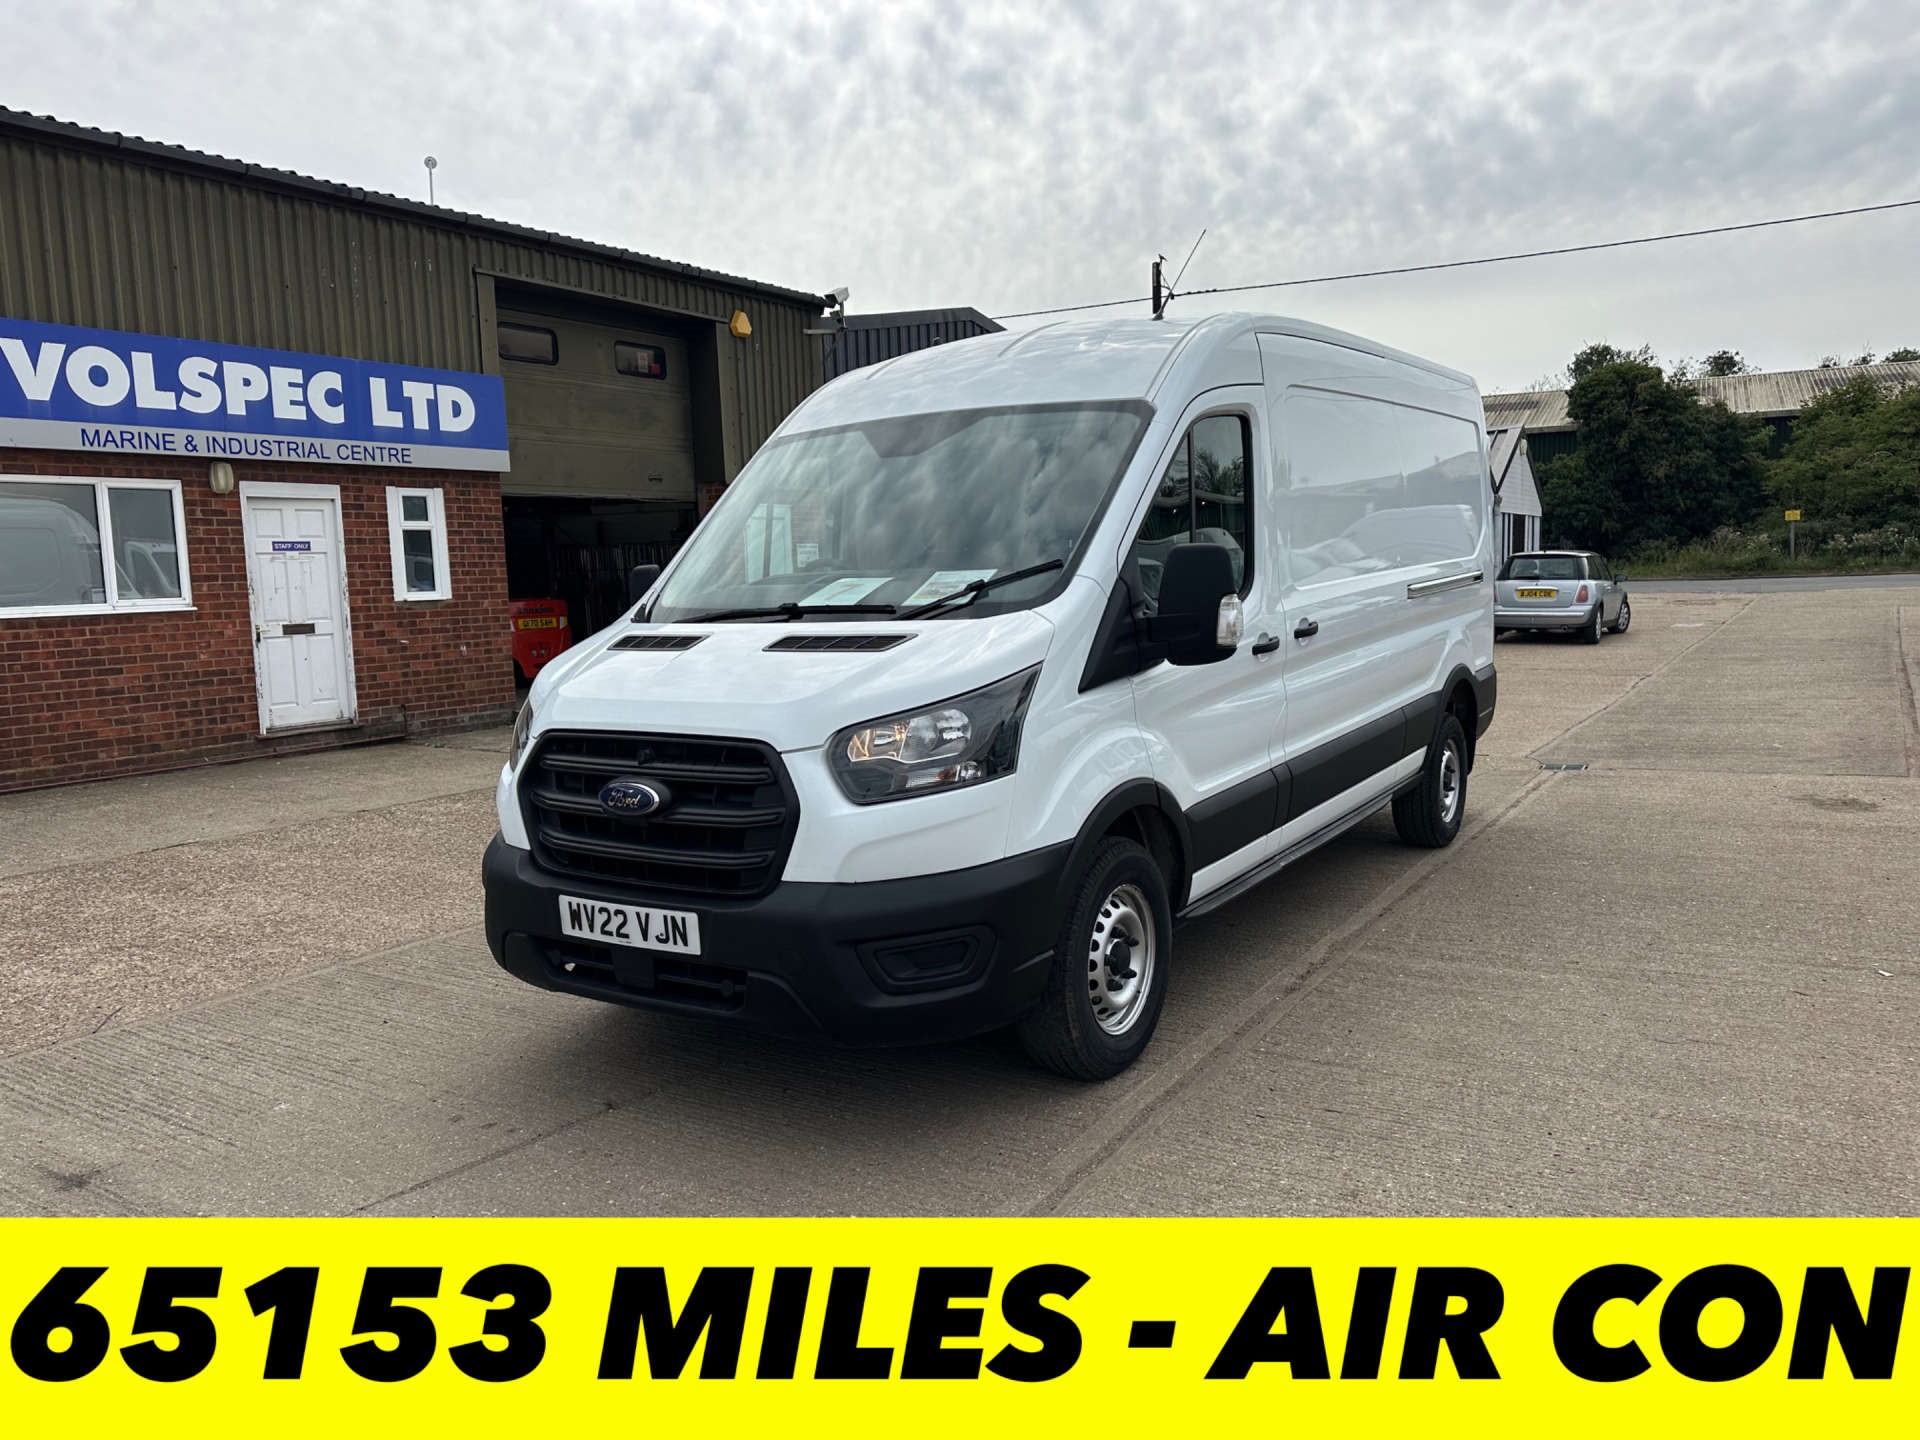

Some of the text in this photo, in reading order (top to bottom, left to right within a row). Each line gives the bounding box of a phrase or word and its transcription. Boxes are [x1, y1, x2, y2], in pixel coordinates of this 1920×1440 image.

[0, 337, 476, 432] VOLSPEC LTD
[81, 428, 413, 464] MARINE & INDUSTRIAL CENTRE
[608, 787, 642, 808] Ford
[568, 901, 630, 939] WV22
